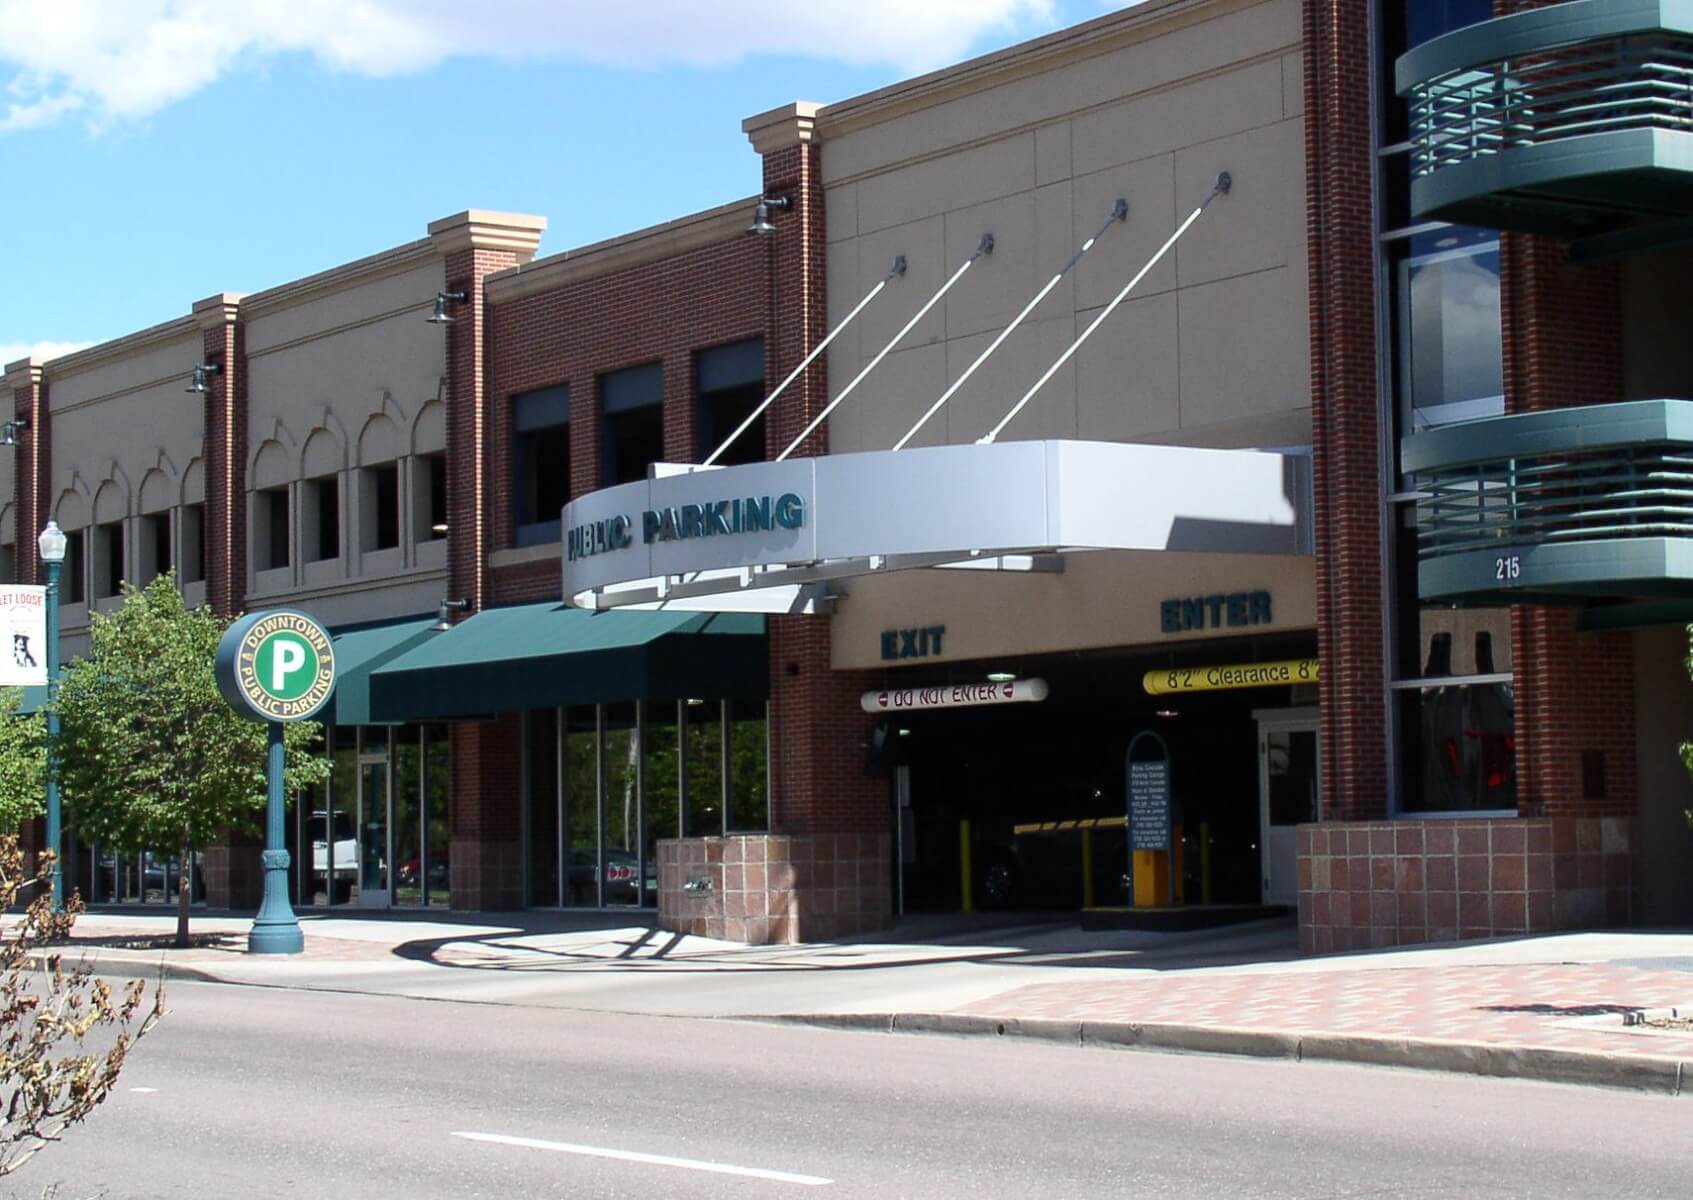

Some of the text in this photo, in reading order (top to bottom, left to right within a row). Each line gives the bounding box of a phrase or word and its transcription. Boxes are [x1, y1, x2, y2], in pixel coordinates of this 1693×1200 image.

[568, 492, 805, 560] PUBLIC PARKING
[1496, 556, 1520, 579] 215
[15, 593, 43, 608] LOOSE
[1160, 590, 1273, 633] ENTER
[246, 616, 327, 651] DOWNTOWN
[881, 625, 946, 660] EXIT
[272, 639, 306, 691] P
[1207, 664, 1290, 687] Clearance
[241, 667, 332, 714] PUBLIC PARKING
[894, 682, 998, 707] DO NOT ENTER
